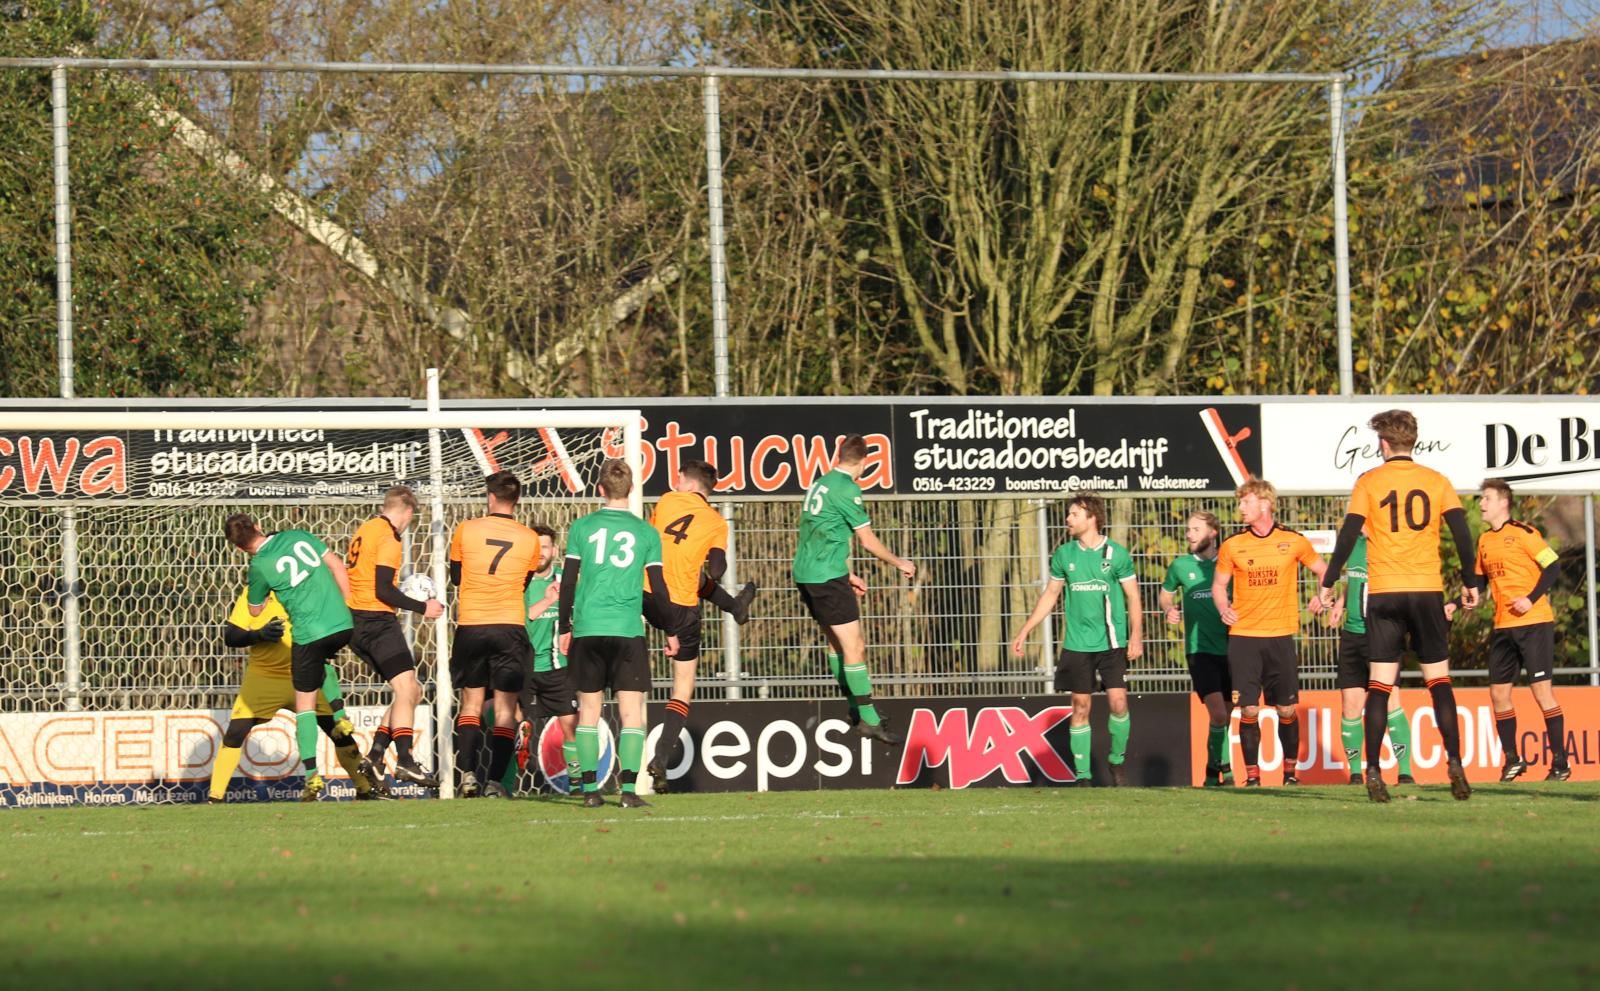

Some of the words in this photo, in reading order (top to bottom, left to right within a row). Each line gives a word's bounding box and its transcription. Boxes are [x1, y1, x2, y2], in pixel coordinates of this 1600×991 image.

[909, 408, 1076, 440] Traditioneel
[151, 442, 421, 480] stucadoorsbedrijf
[913, 437, 1168, 475] stucadoorsbedrijf
[1483, 423, 1547, 470] De
[803, 481, 829, 515] 15
[912, 476, 995, 491] 0516-423229
[1005, 475, 1128, 493] boonstra.g@online.nl
[1138, 475, 1209, 490] Waskemeer
[664, 513, 695, 545] 4
[1379, 488, 1431, 533] 10
[275, 540, 322, 588] 20
[348, 536, 362, 570] 9
[485, 538, 514, 575] 7
[588, 527, 636, 568] 13
[646, 719, 873, 792] pepsi
[895, 707, 1078, 790] MAX
[18, 790, 74, 805] Rolluiken
[84, 791, 126, 804] Horren
[135, 789, 197, 802] Markiezen
